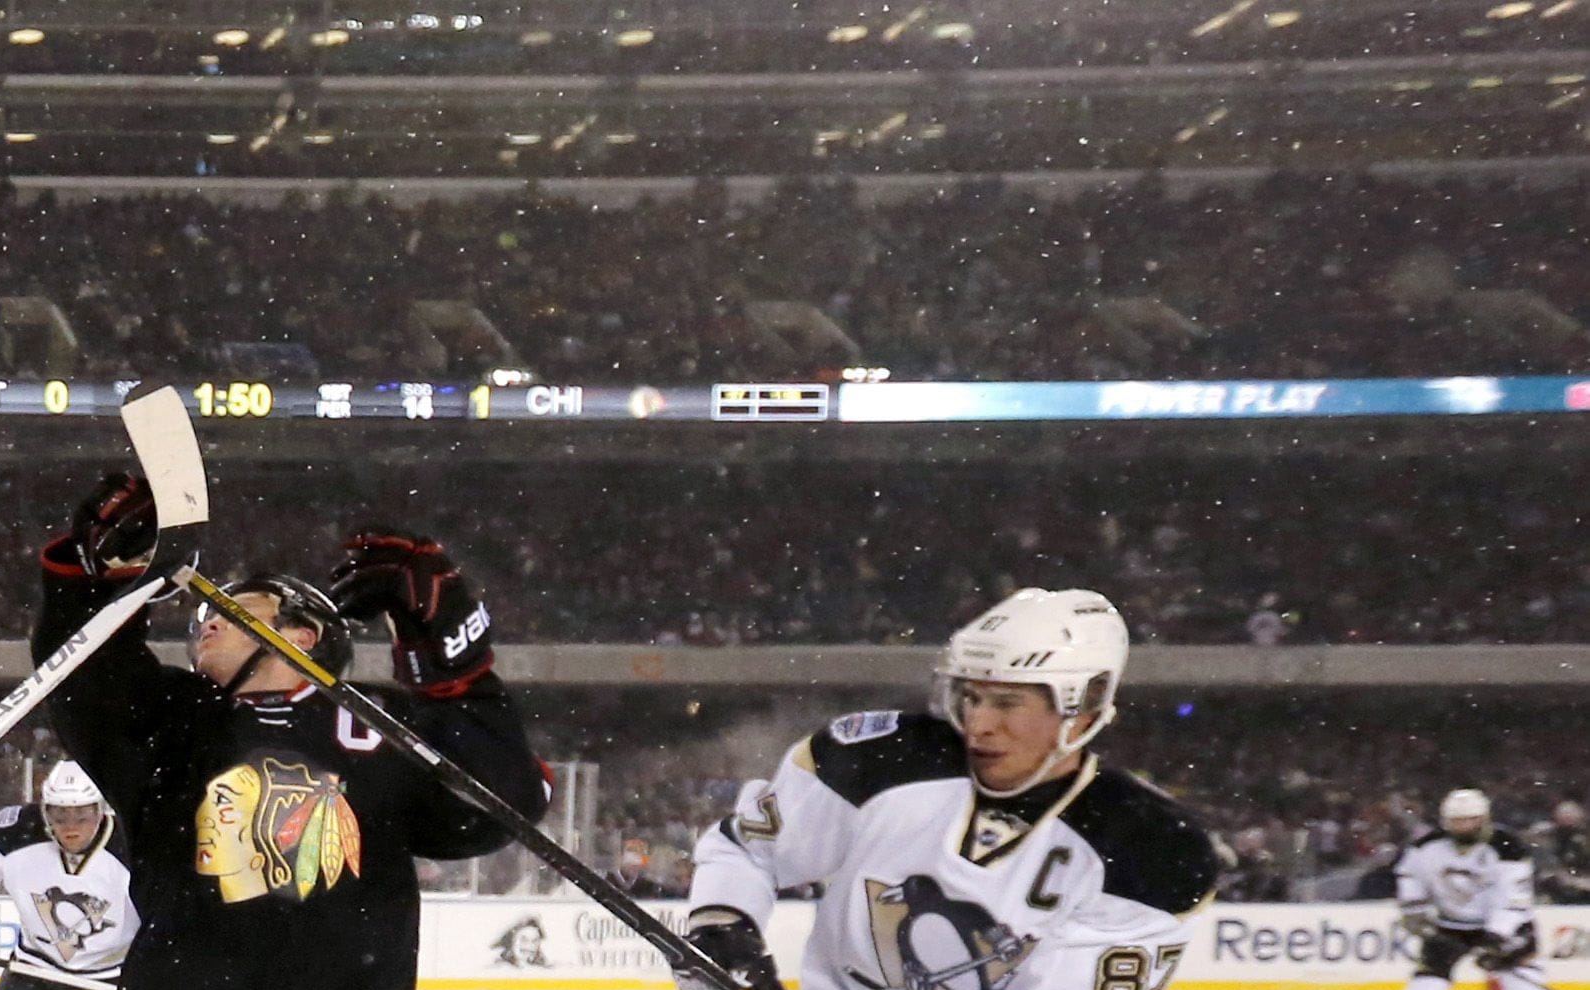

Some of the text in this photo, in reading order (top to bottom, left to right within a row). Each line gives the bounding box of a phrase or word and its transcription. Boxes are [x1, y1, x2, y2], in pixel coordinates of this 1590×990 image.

[45, 381, 70, 414] 0
[193, 383, 273, 417] 1:50
[469, 386, 491, 419] 1
[525, 385, 583, 415] CHI
[737, 793, 784, 844] 7
[1025, 846, 1072, 912] C
[1214, 917, 1418, 963] Reebok
